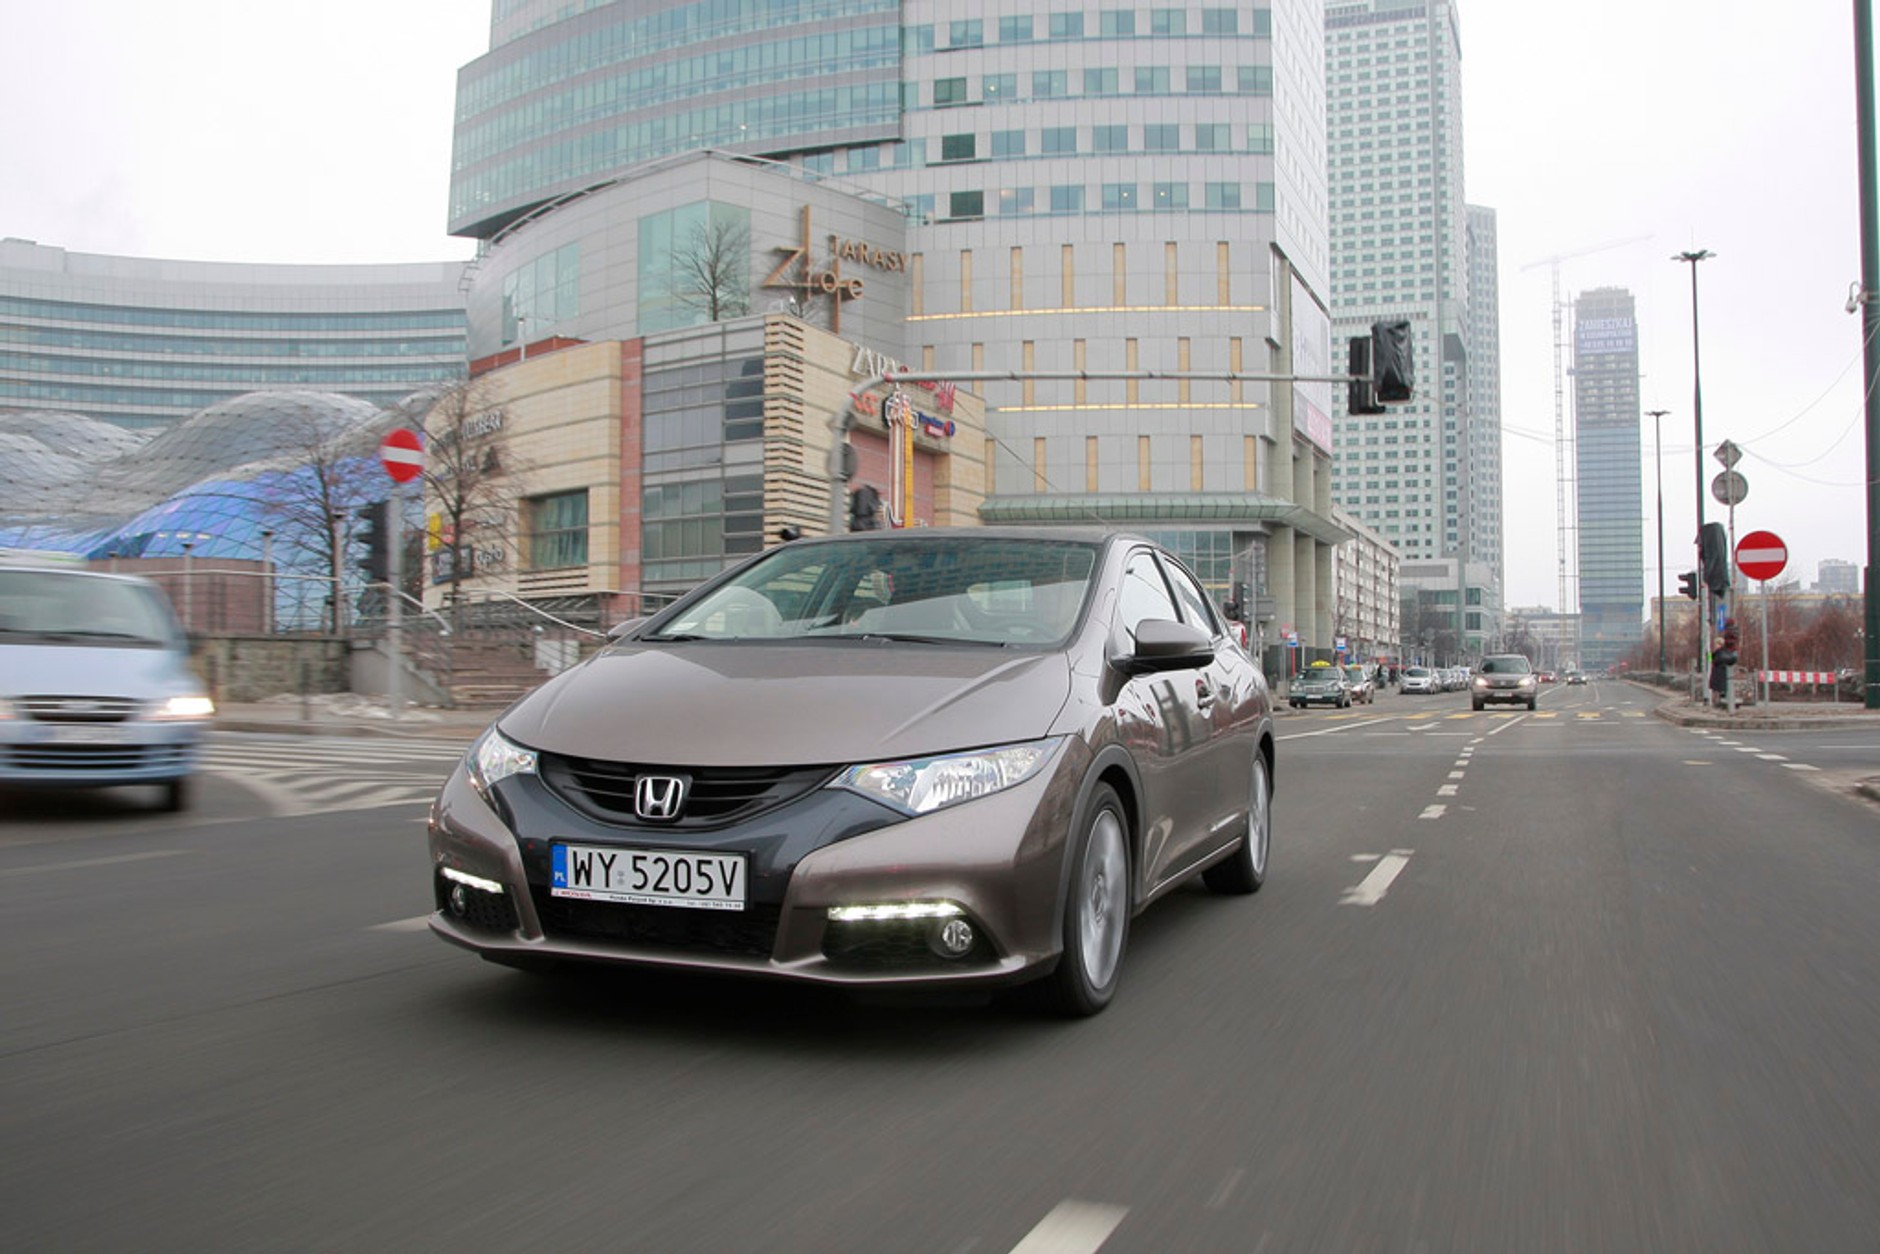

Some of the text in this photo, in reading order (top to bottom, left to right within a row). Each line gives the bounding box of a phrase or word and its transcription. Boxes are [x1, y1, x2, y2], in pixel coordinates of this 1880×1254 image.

[829, 233, 909, 275] TARASY
[572, 850, 739, 897] WY 5205V
